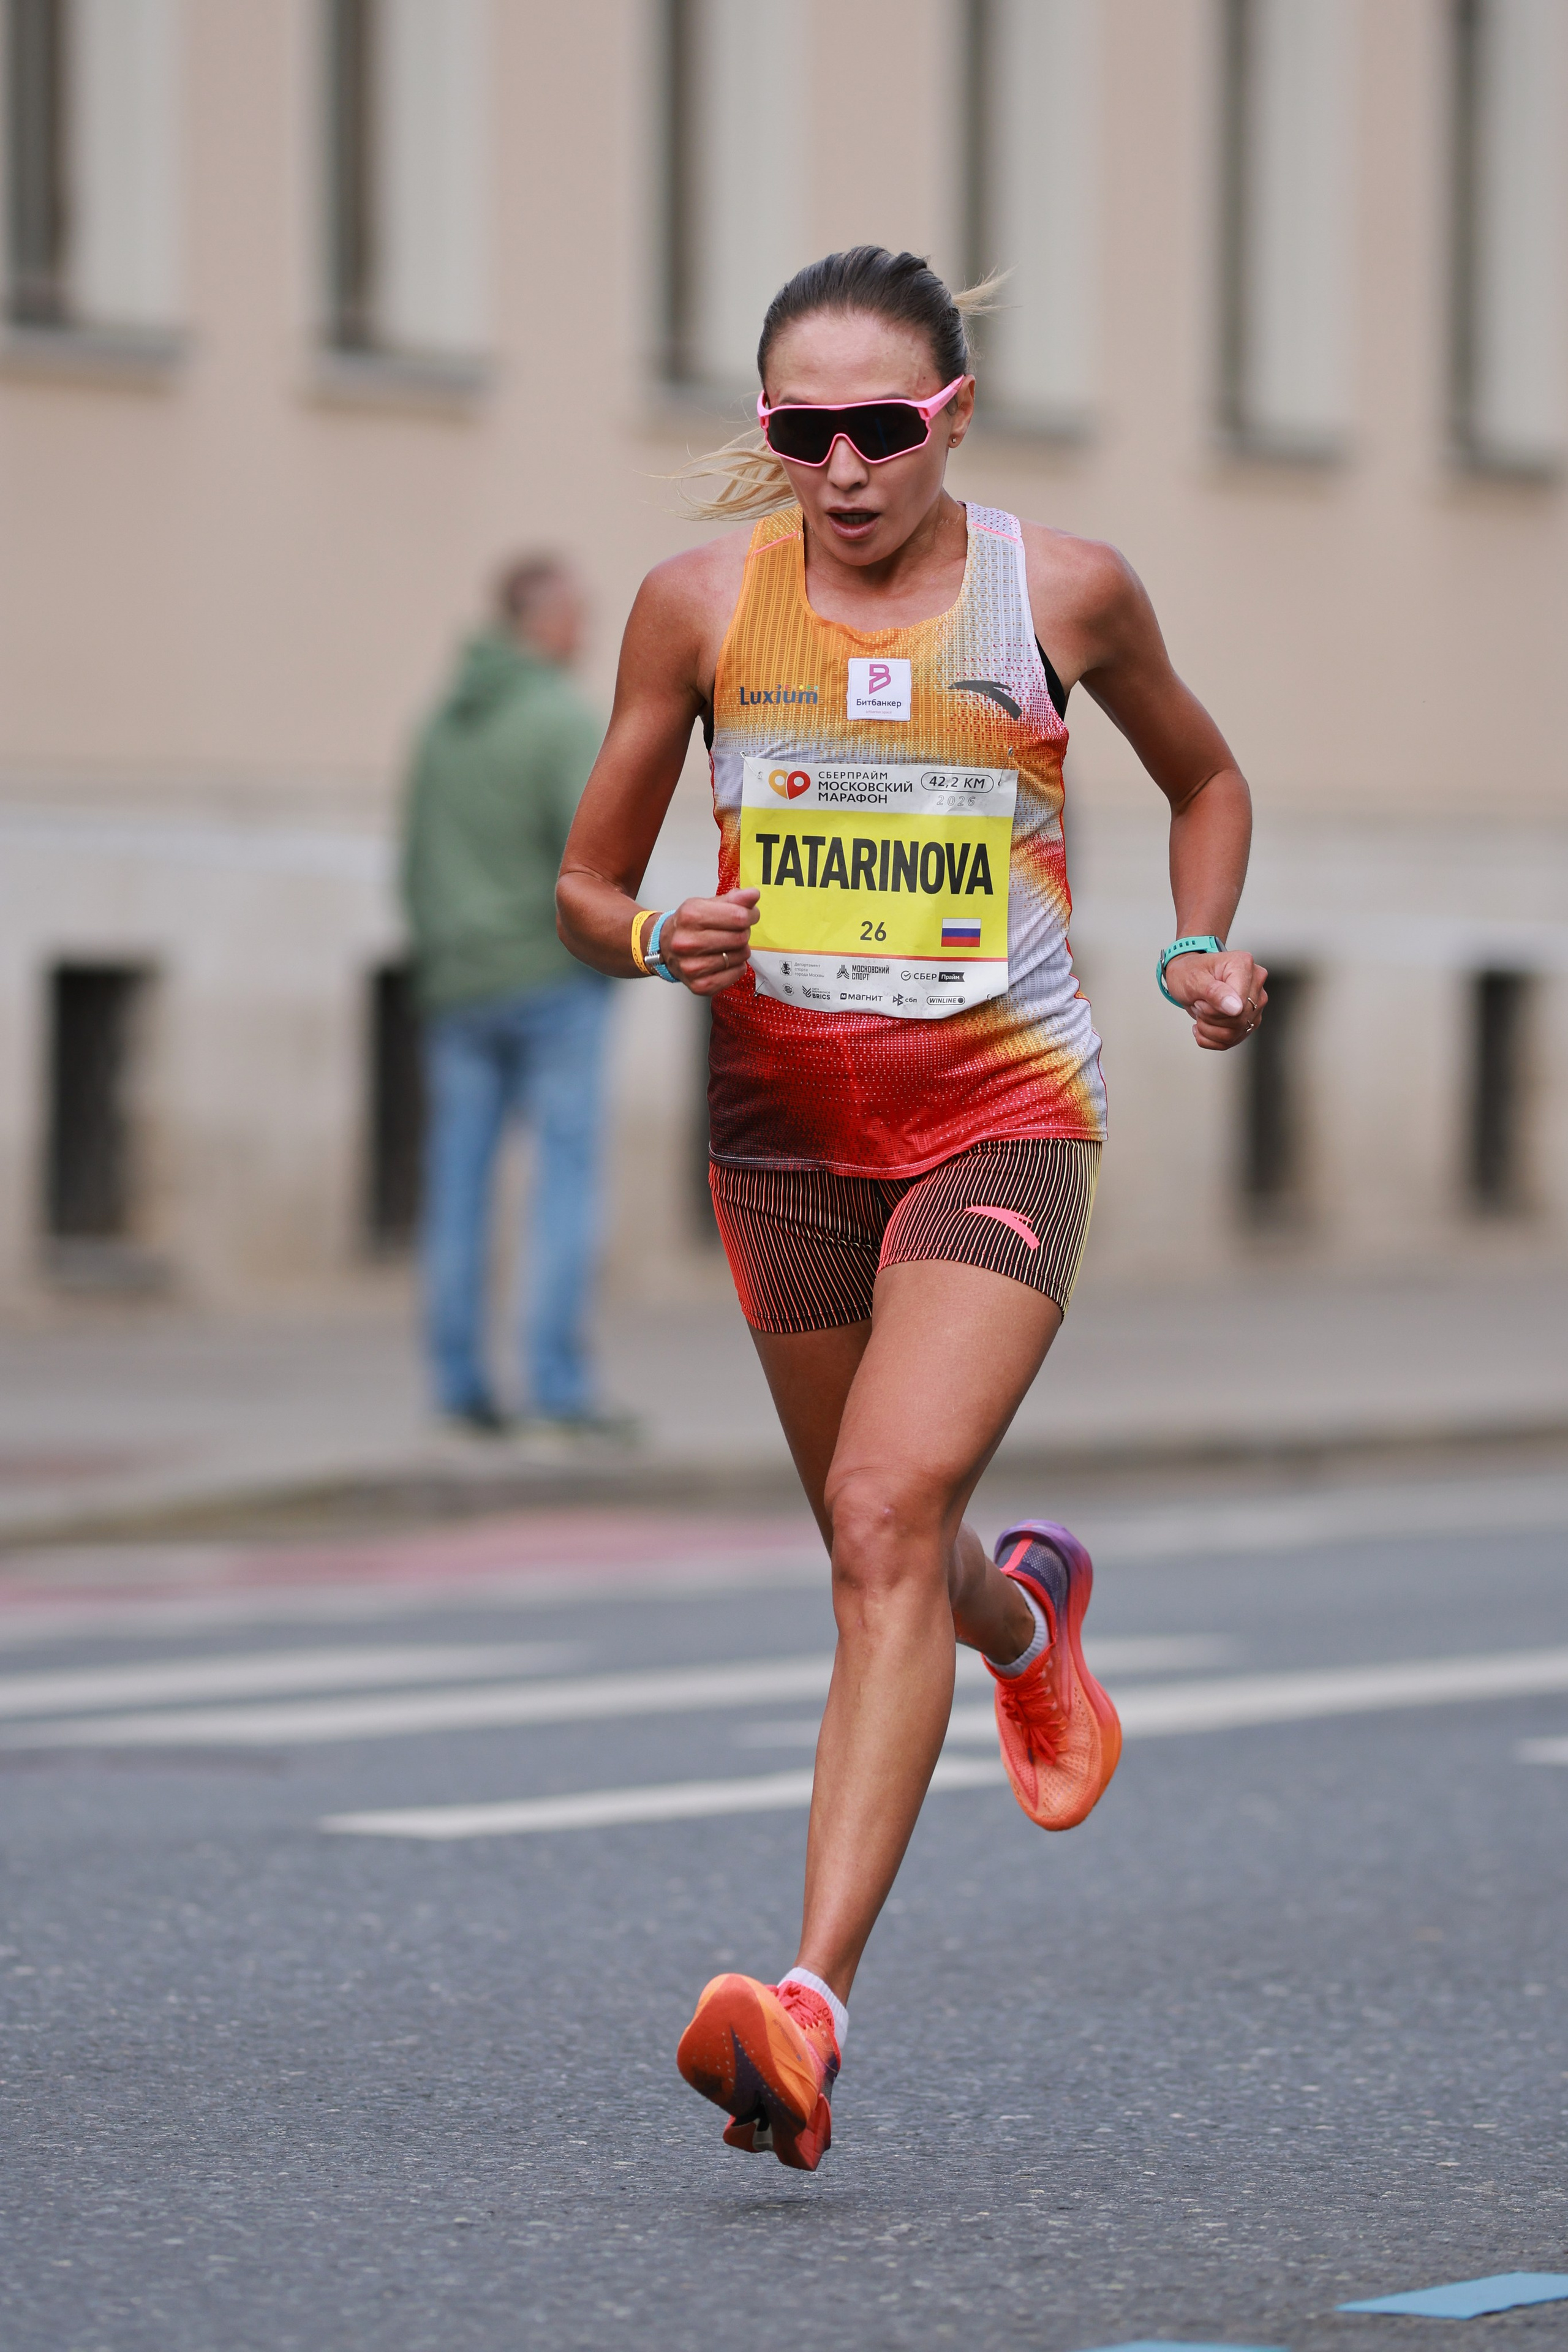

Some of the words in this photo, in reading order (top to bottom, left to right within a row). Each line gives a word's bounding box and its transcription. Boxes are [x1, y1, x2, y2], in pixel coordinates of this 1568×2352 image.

[740, 684, 818, 705] Luxium
[856, 698, 902, 709] Битбанкер
[818, 771, 888, 780] СБЕРПРАЙМ
[818, 781, 913, 793] МОСКОВСКИЙ
[929, 776, 959, 788] 42,2
[818, 793, 888, 804] МАРАФОН
[937, 795, 976, 807] 2026
[756, 834, 993, 895] TATARINOVA
[860, 921, 887, 941] 26
[852, 965, 889, 974] МОСКОВСКИЙ
